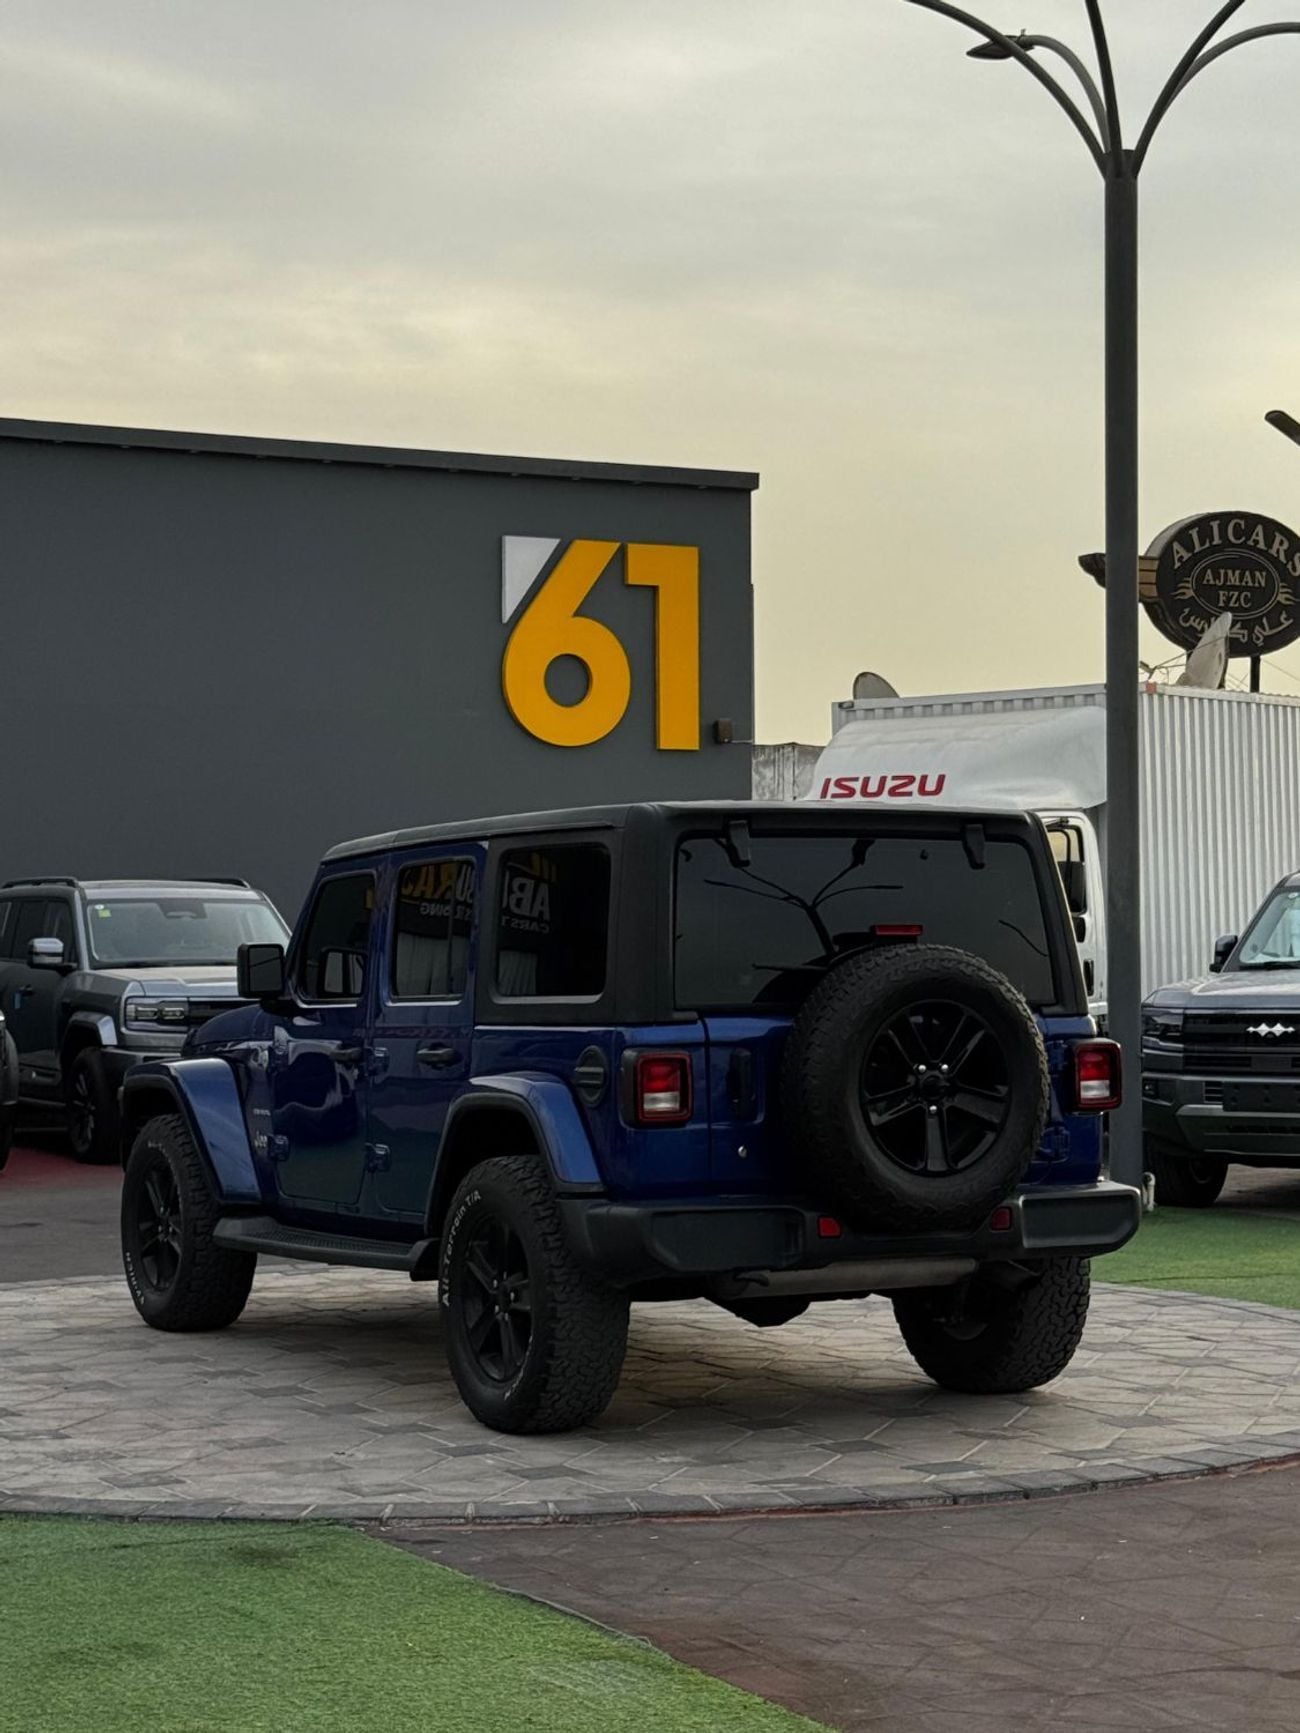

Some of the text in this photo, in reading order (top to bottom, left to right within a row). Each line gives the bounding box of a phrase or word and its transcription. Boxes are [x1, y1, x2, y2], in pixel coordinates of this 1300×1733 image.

[1202, 568, 1267, 588] AJMAN
[1217, 590, 1252, 608] FZC
[502, 538, 700, 750] 61
[820, 774, 946, 799] ISUZU
